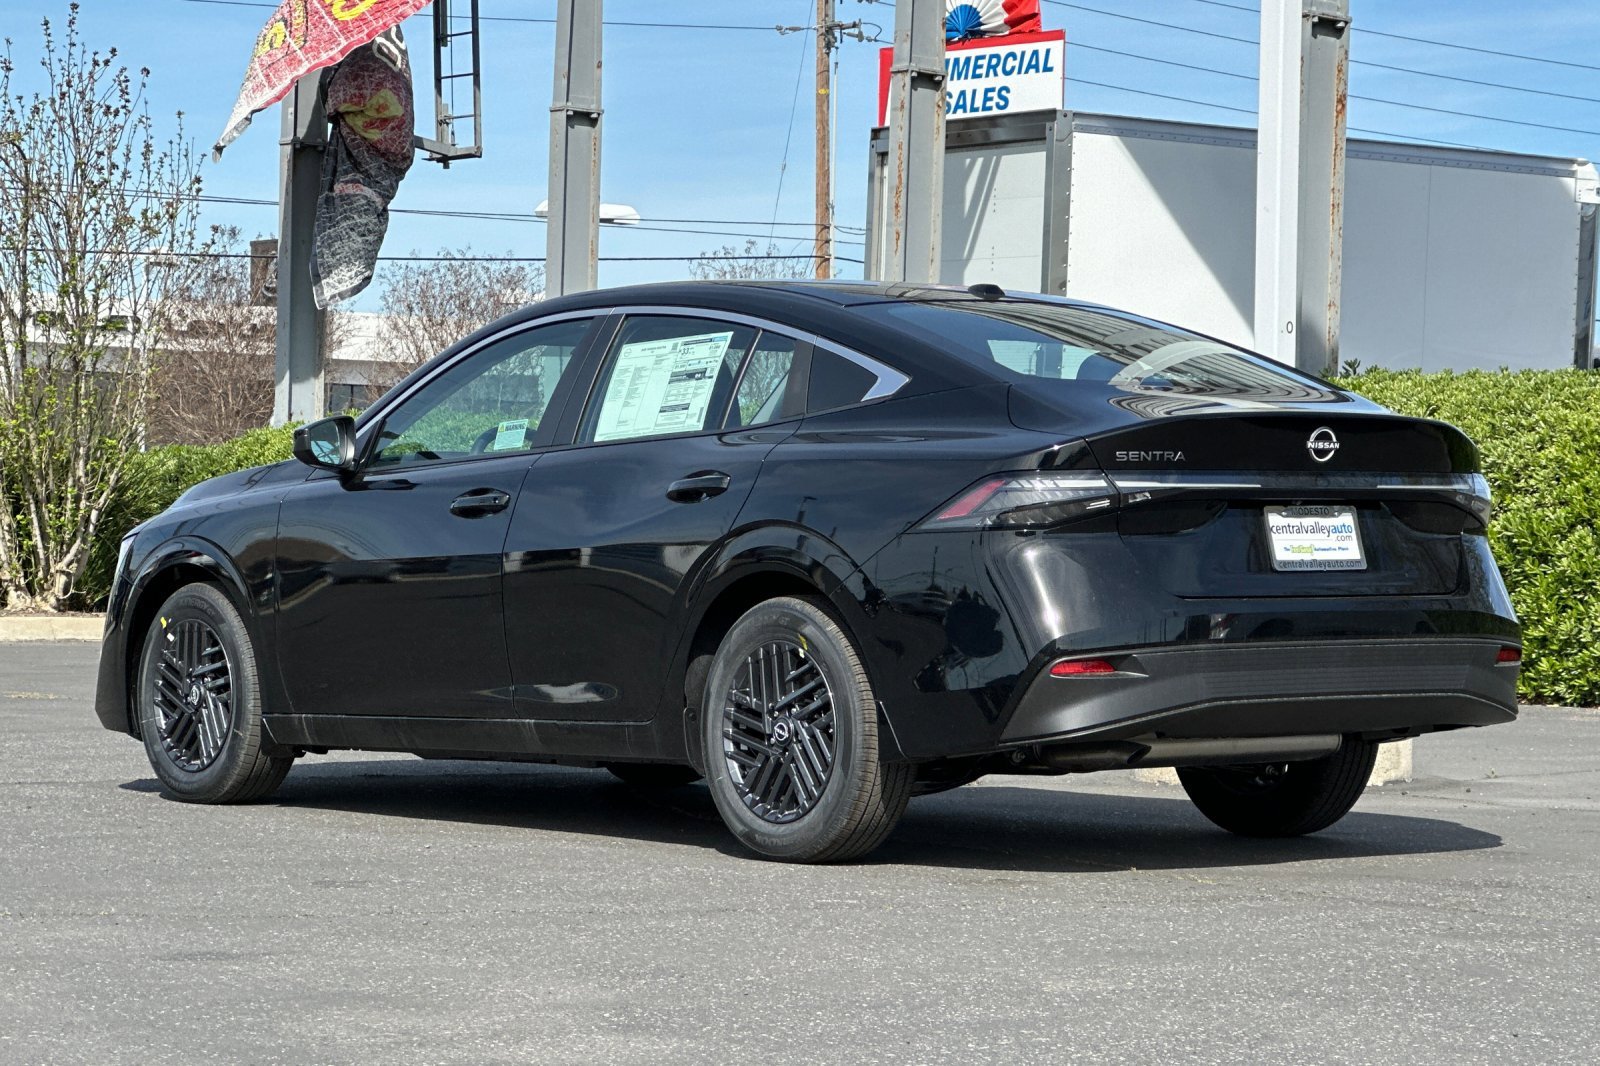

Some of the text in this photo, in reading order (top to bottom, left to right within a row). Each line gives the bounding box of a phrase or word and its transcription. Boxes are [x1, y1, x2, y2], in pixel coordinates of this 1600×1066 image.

[945, 48, 1054, 81] MERCIAL
[1307, 440, 1340, 449] NISSAN
[1115, 451, 1186, 462] SENTRA
[1270, 522, 1353, 537] centralvalleyauto
[1279, 559, 1362, 569] centralvalleyauto.com
